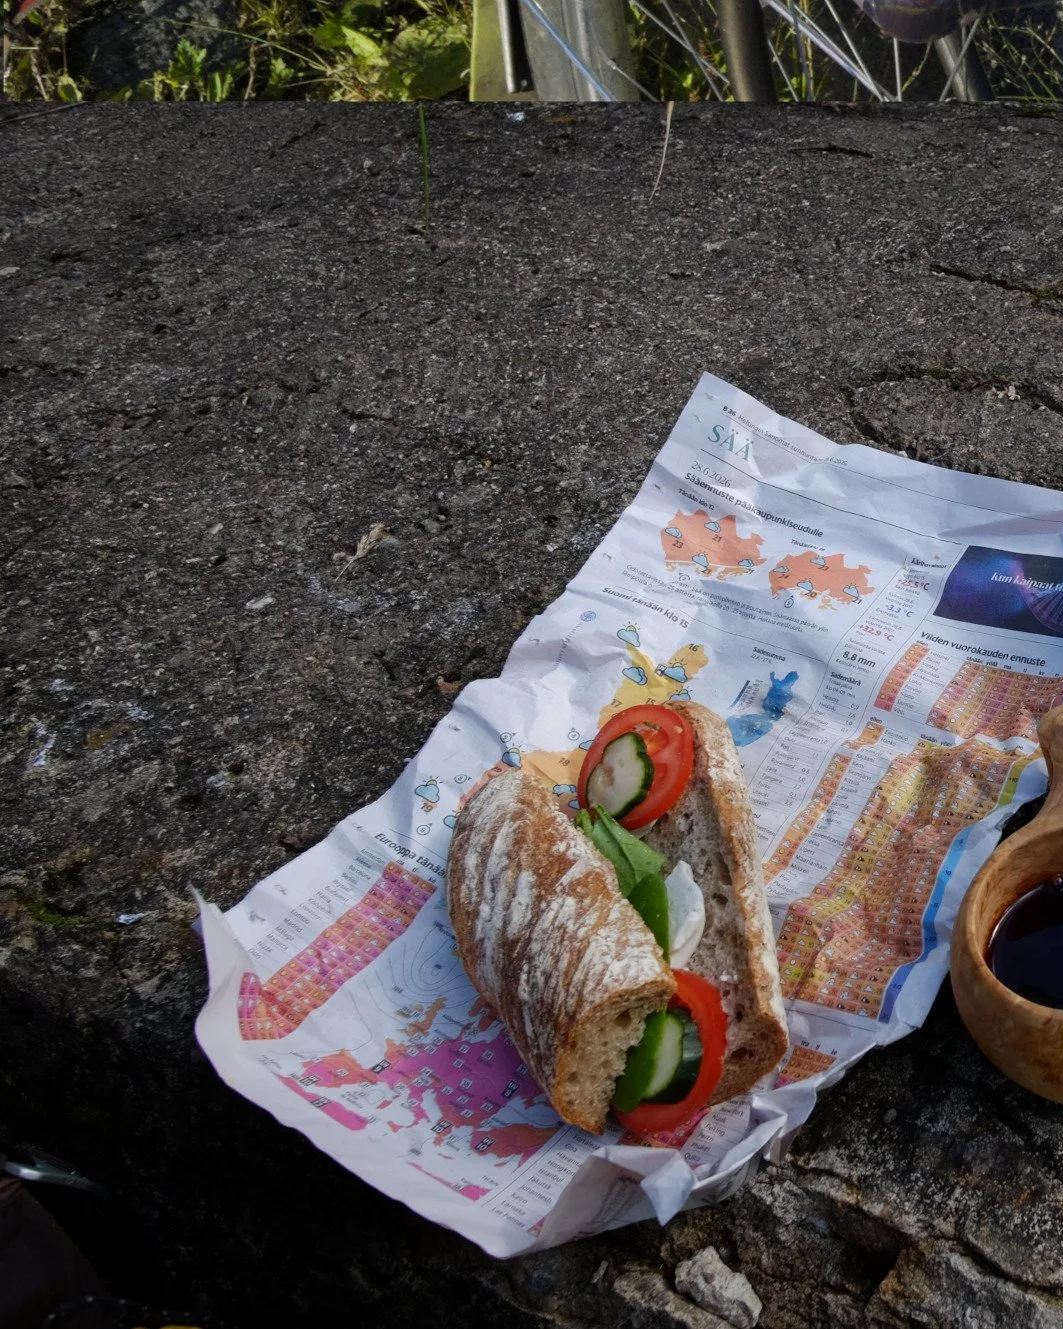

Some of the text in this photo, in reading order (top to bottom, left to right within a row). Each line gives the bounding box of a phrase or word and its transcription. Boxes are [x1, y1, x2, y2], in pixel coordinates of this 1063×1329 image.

[708, 424, 754, 461] SÄÄ
[691, 460, 731, 488] 28.6.2026
[685, 472, 824, 538] Sääennuste pääkaupunkiseudulle
[672, 539, 684, 549] 23
[712, 534, 722, 543] 21
[1013, 575, 1053, 590] kaipaat
[631, 595, 663, 615] tänään
[662, 609, 679, 623] klo
[677, 618, 689, 629] 15
[860, 625, 881, 636] +32,9
[688, 642, 699, 653] 16
[921, 632, 1046, 667] Viiden vuorokauden ennuste
[842, 651, 876, 668] 8,8 mm
[611, 699, 622, 708] 17
[559, 757, 570, 766] 18
[421, 802, 433, 812] 19
[374, 833, 416, 861] Eurooppa
[546, 1158, 577, 1178] Hongkon
